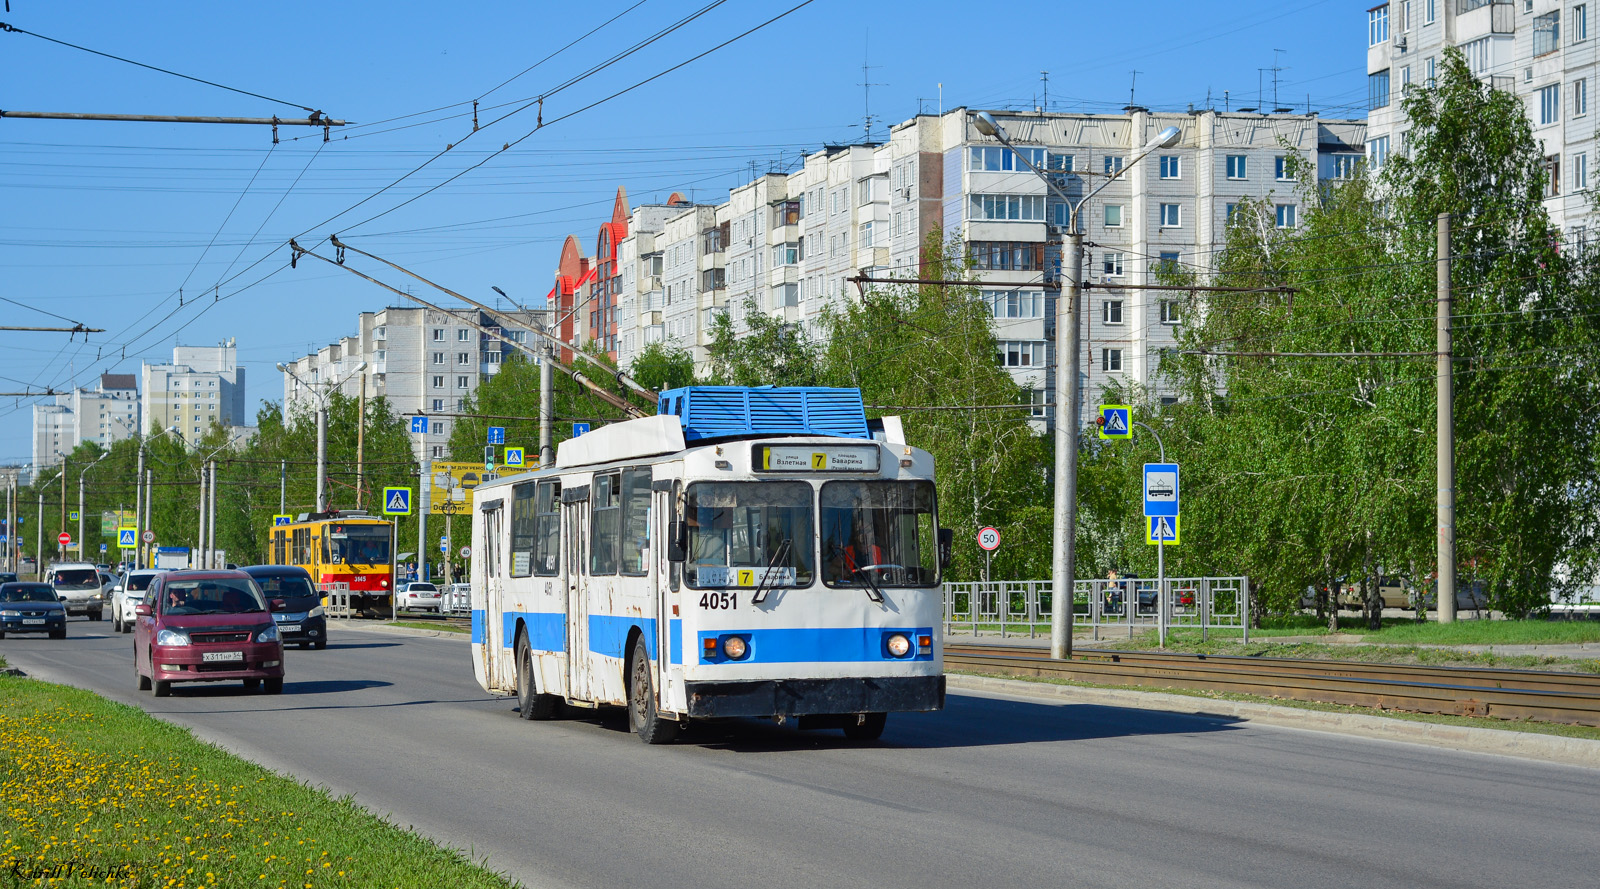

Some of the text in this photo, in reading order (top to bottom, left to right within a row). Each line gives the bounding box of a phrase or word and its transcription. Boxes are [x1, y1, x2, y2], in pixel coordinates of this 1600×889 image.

[776, 458, 807, 466] Взлетная
[815, 455, 824, 467] 7
[831, 457, 863, 465] Баварина
[983, 534, 995, 543] 50
[742, 572, 750, 584] 7
[699, 592, 737, 610] 4051
